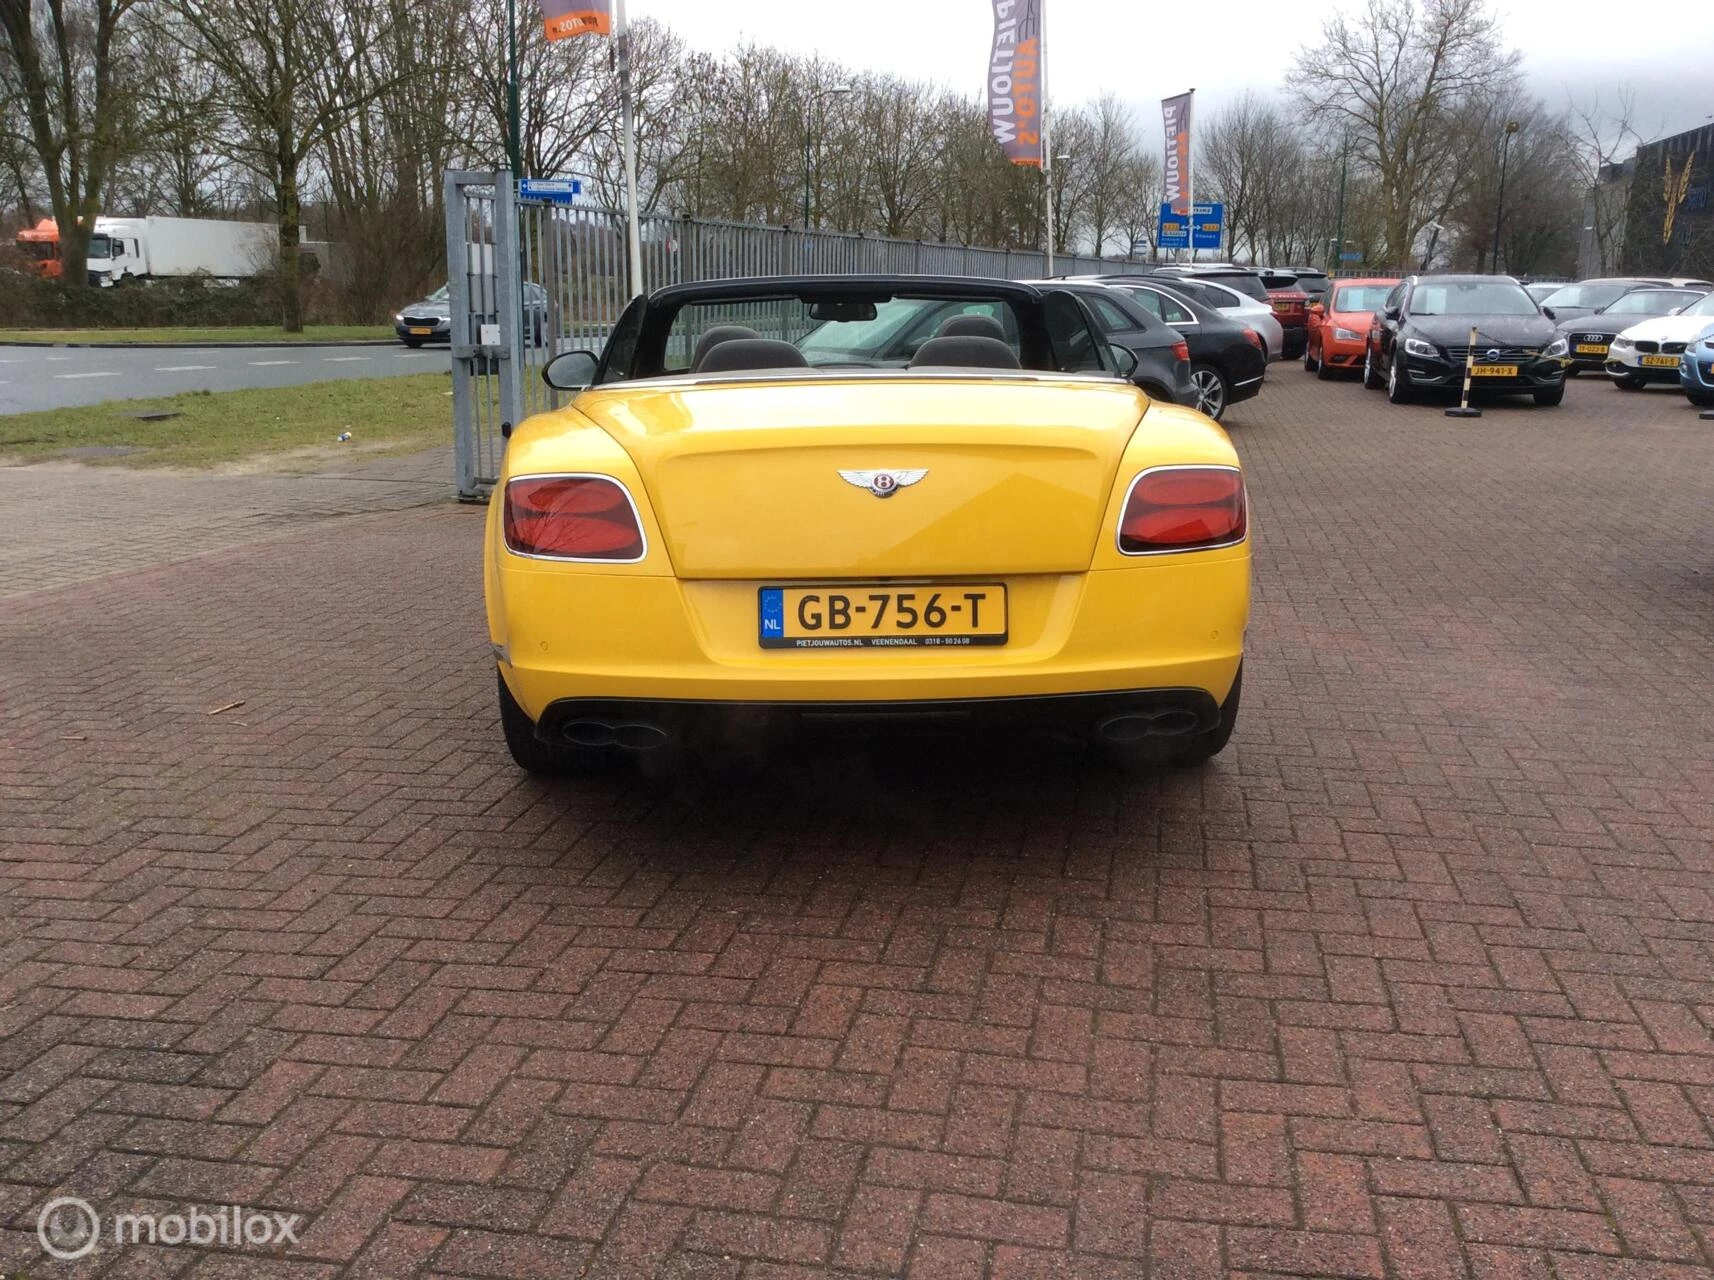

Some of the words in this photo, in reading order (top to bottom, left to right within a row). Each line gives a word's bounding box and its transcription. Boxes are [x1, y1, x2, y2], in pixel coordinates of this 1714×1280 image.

[797, 593, 986, 631] GB-756-T
[764, 619, 781, 630] NL
[796, 639, 864, 647] PIETJOUWAUTOS.NL
[871, 638, 918, 646] VEENENDAAL
